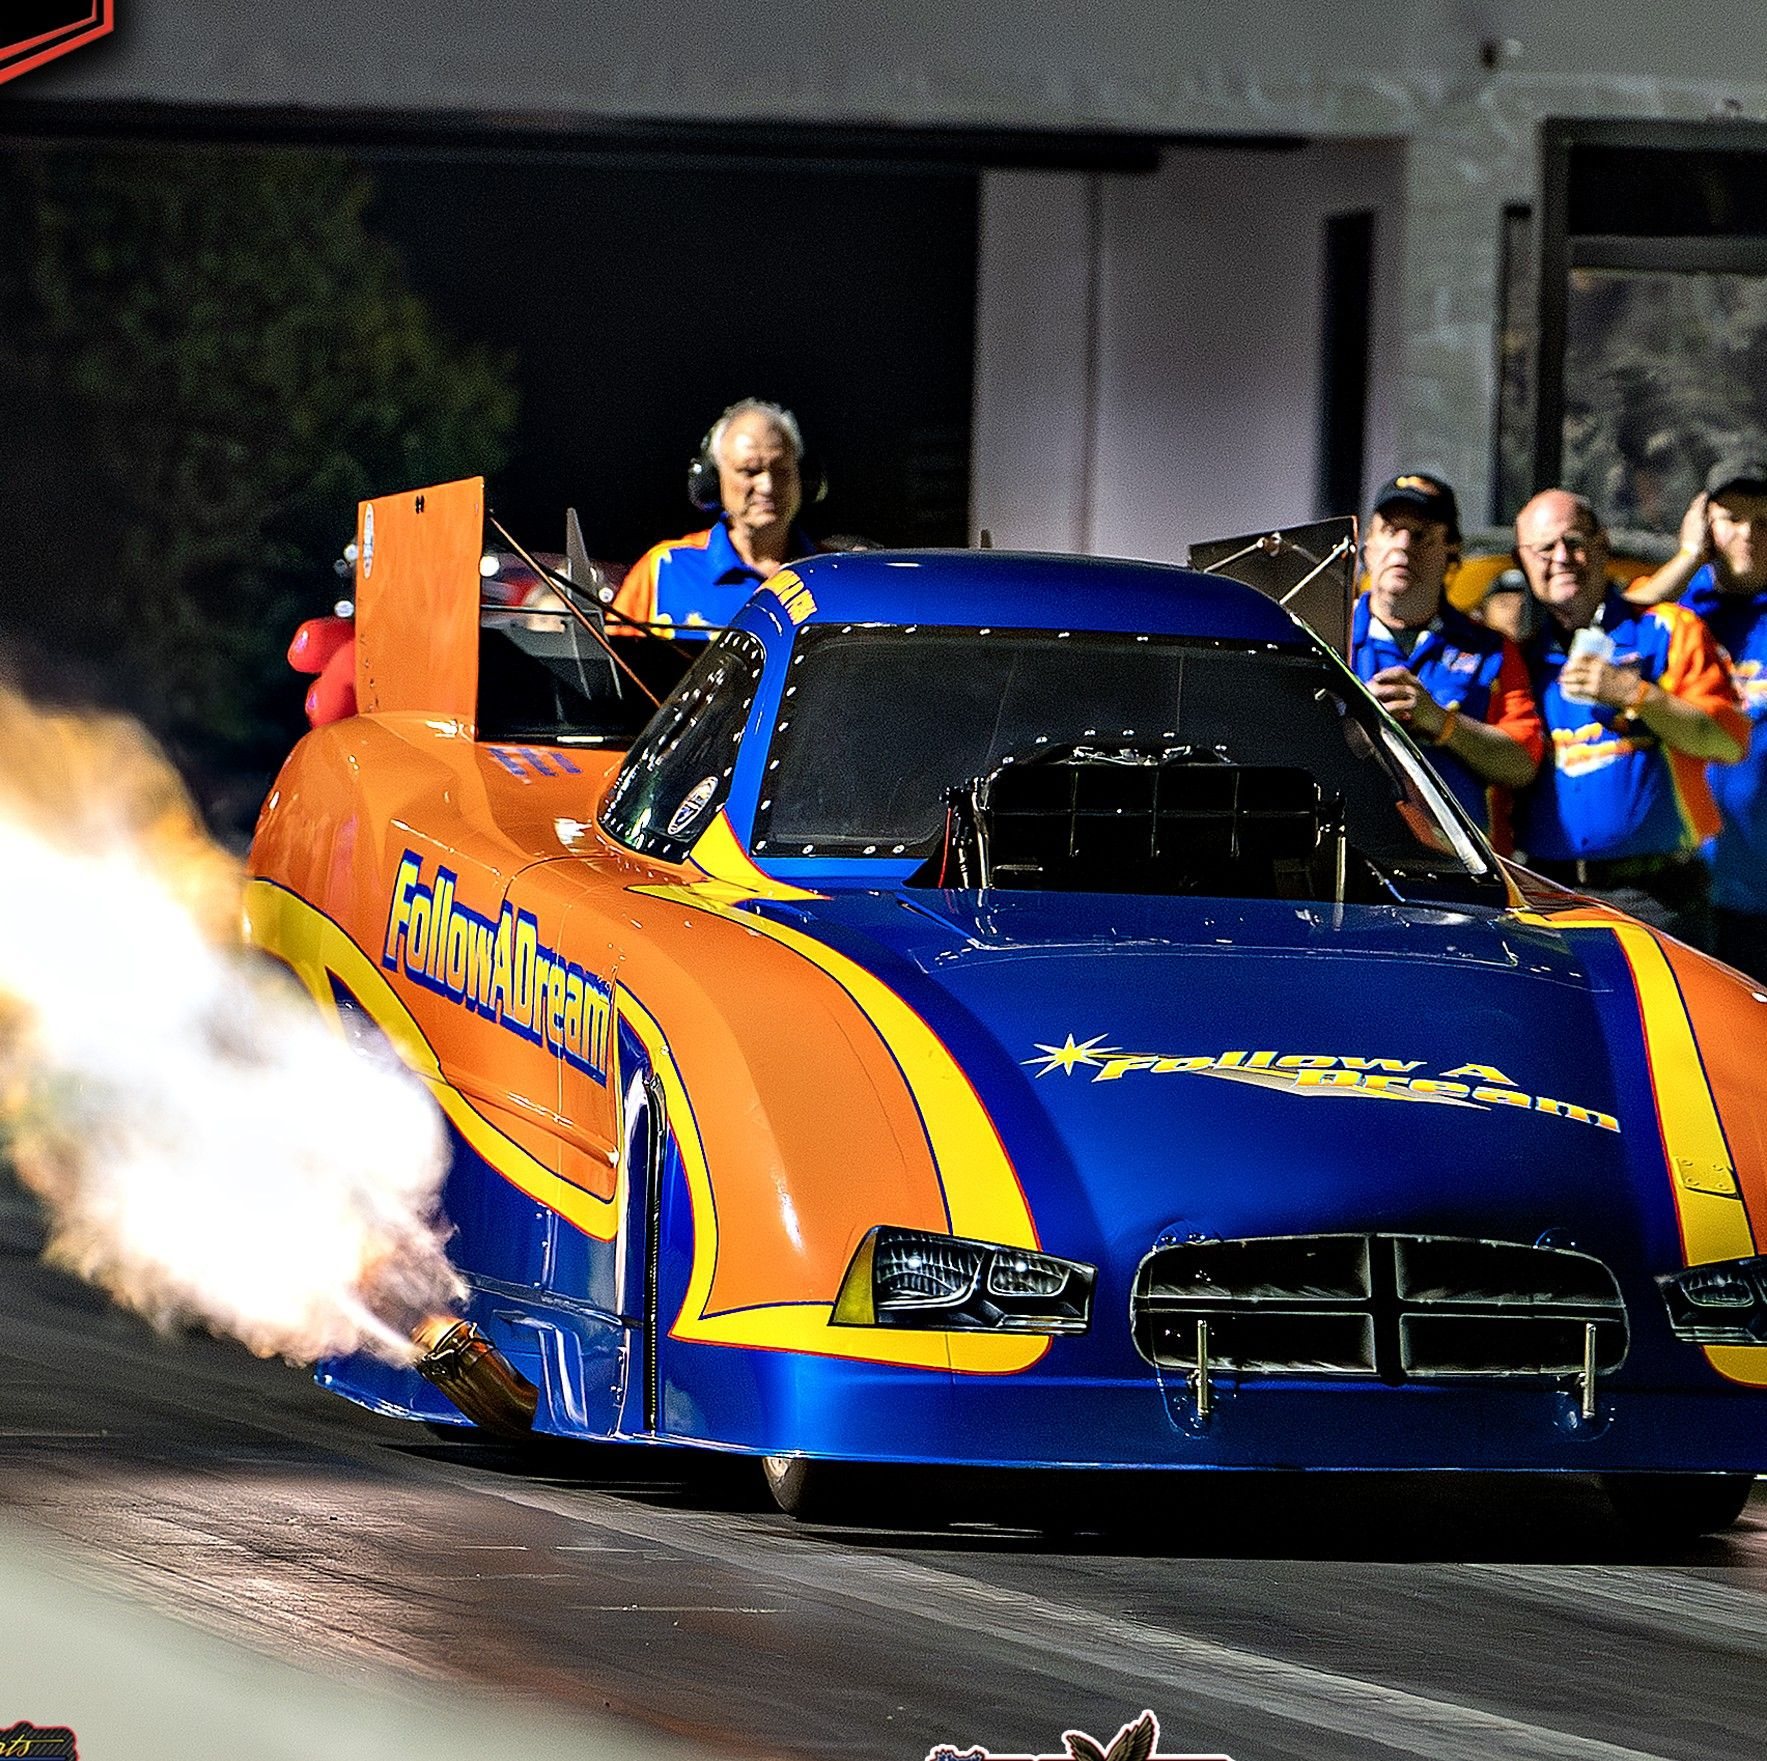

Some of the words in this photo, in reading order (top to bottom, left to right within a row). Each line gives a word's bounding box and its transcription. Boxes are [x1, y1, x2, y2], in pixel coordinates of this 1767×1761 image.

[1092, 1051, 1427, 1083] Follow
[1439, 1062, 1518, 1087] A
[1291, 1066, 1622, 1133] Dream
